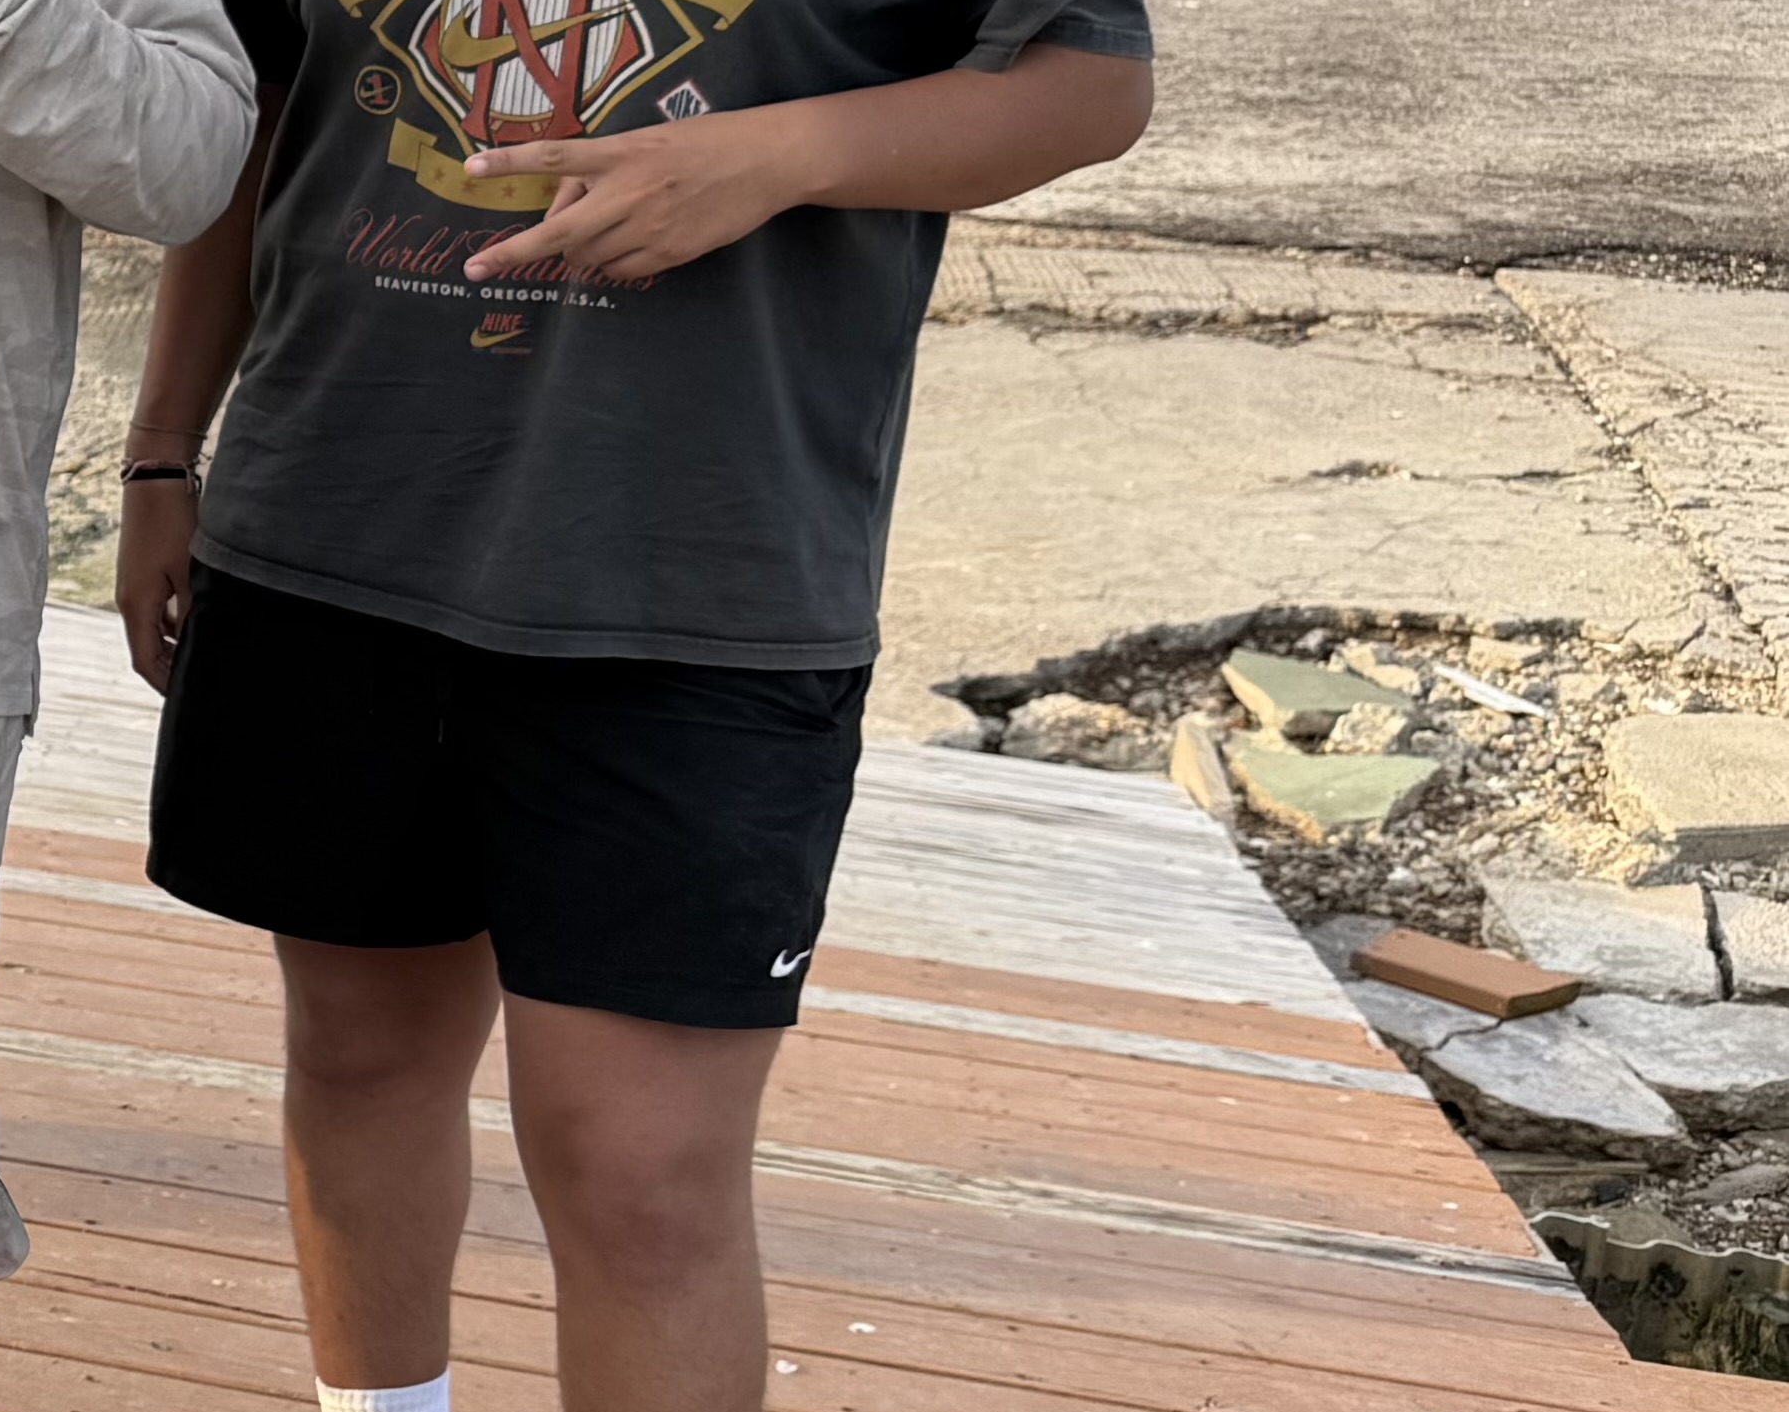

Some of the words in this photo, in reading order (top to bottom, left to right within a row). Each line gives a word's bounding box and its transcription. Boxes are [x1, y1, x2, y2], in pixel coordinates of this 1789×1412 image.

[343, 208, 468, 276] World
[375, 275, 471, 298] BEAVERTON,
[480, 287, 559, 302] OREGON
[481, 313, 523, 331] NIKE
